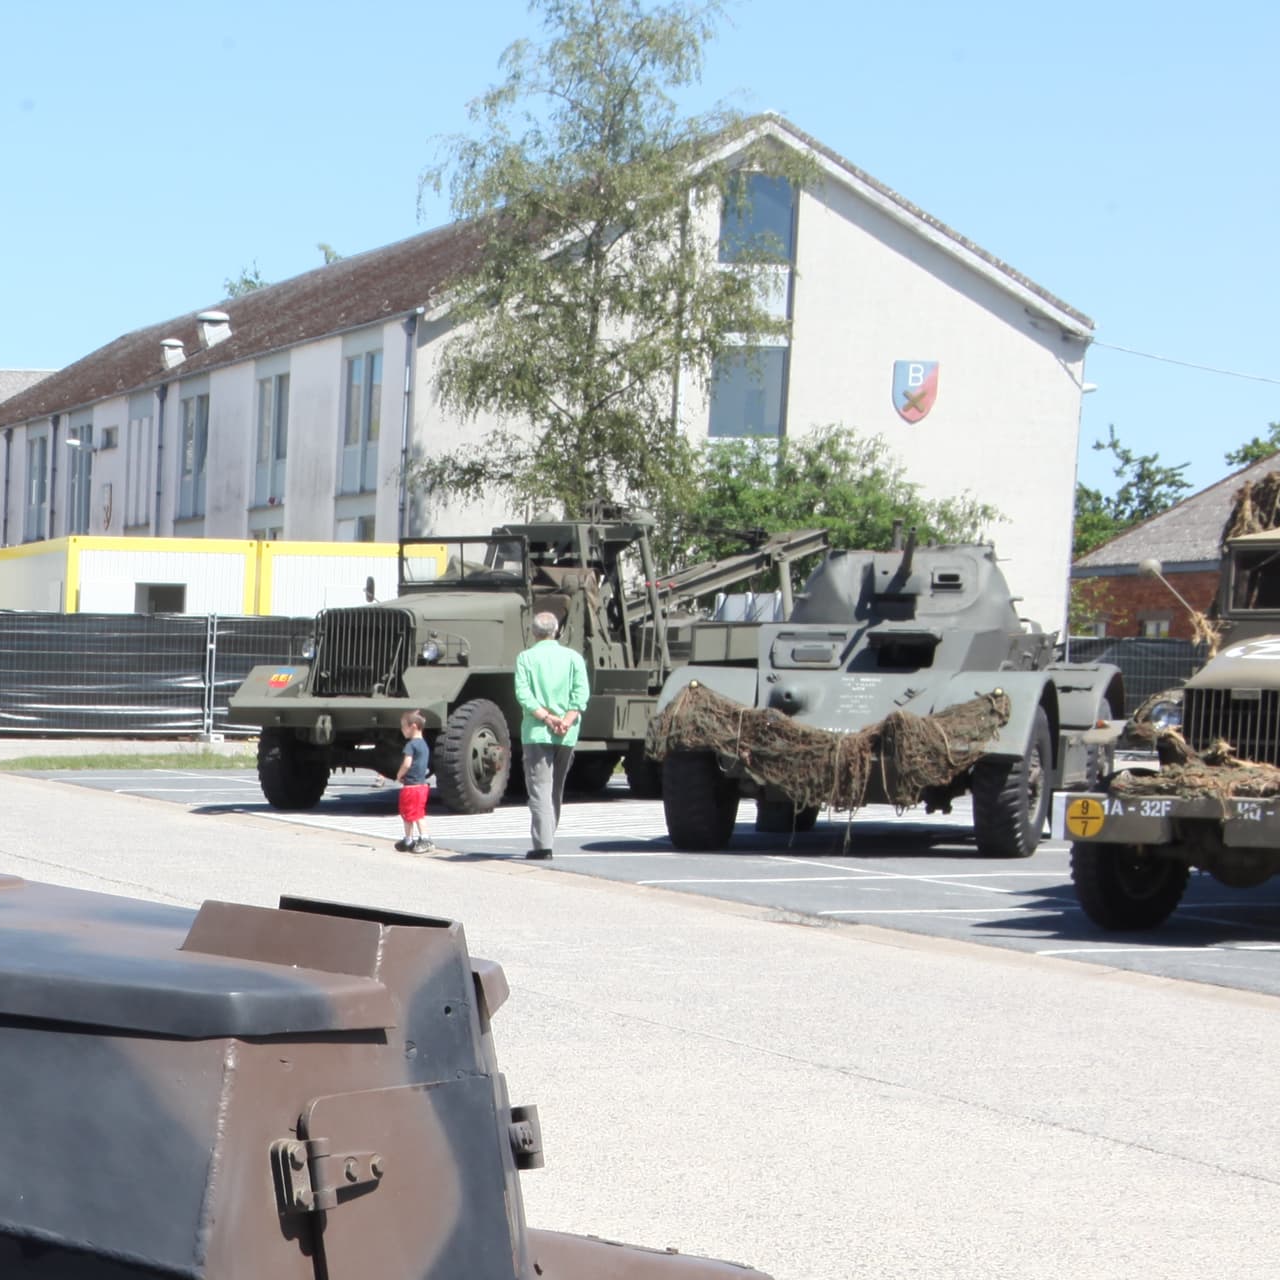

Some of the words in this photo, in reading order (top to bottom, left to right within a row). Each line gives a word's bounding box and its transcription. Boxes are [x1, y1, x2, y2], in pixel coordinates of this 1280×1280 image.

[909, 364, 924, 386] B
[1081, 800, 1090, 816] 9
[1102, 799, 1123, 816] 1A
[1140, 801, 1172, 817] 32F
[1081, 821, 1089, 837] 7
